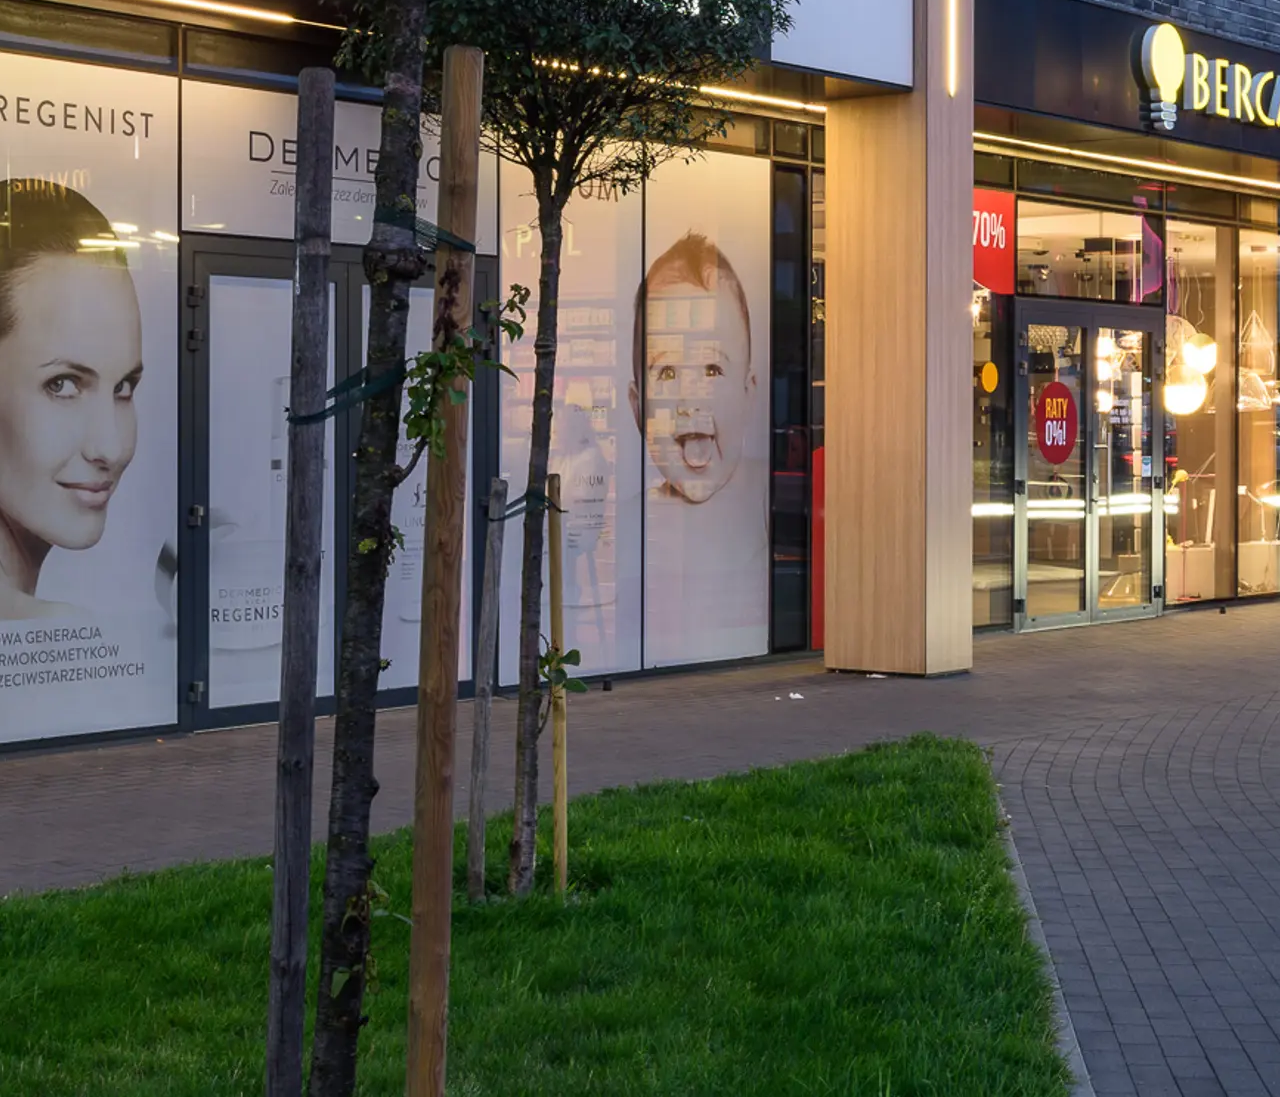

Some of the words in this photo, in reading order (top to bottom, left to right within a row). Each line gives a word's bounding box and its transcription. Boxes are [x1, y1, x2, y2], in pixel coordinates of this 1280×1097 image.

[1045, 397, 1069, 419] RATY
[211, 603, 285, 622] REGENIS
[25, 626, 102, 645] GENERACJA
